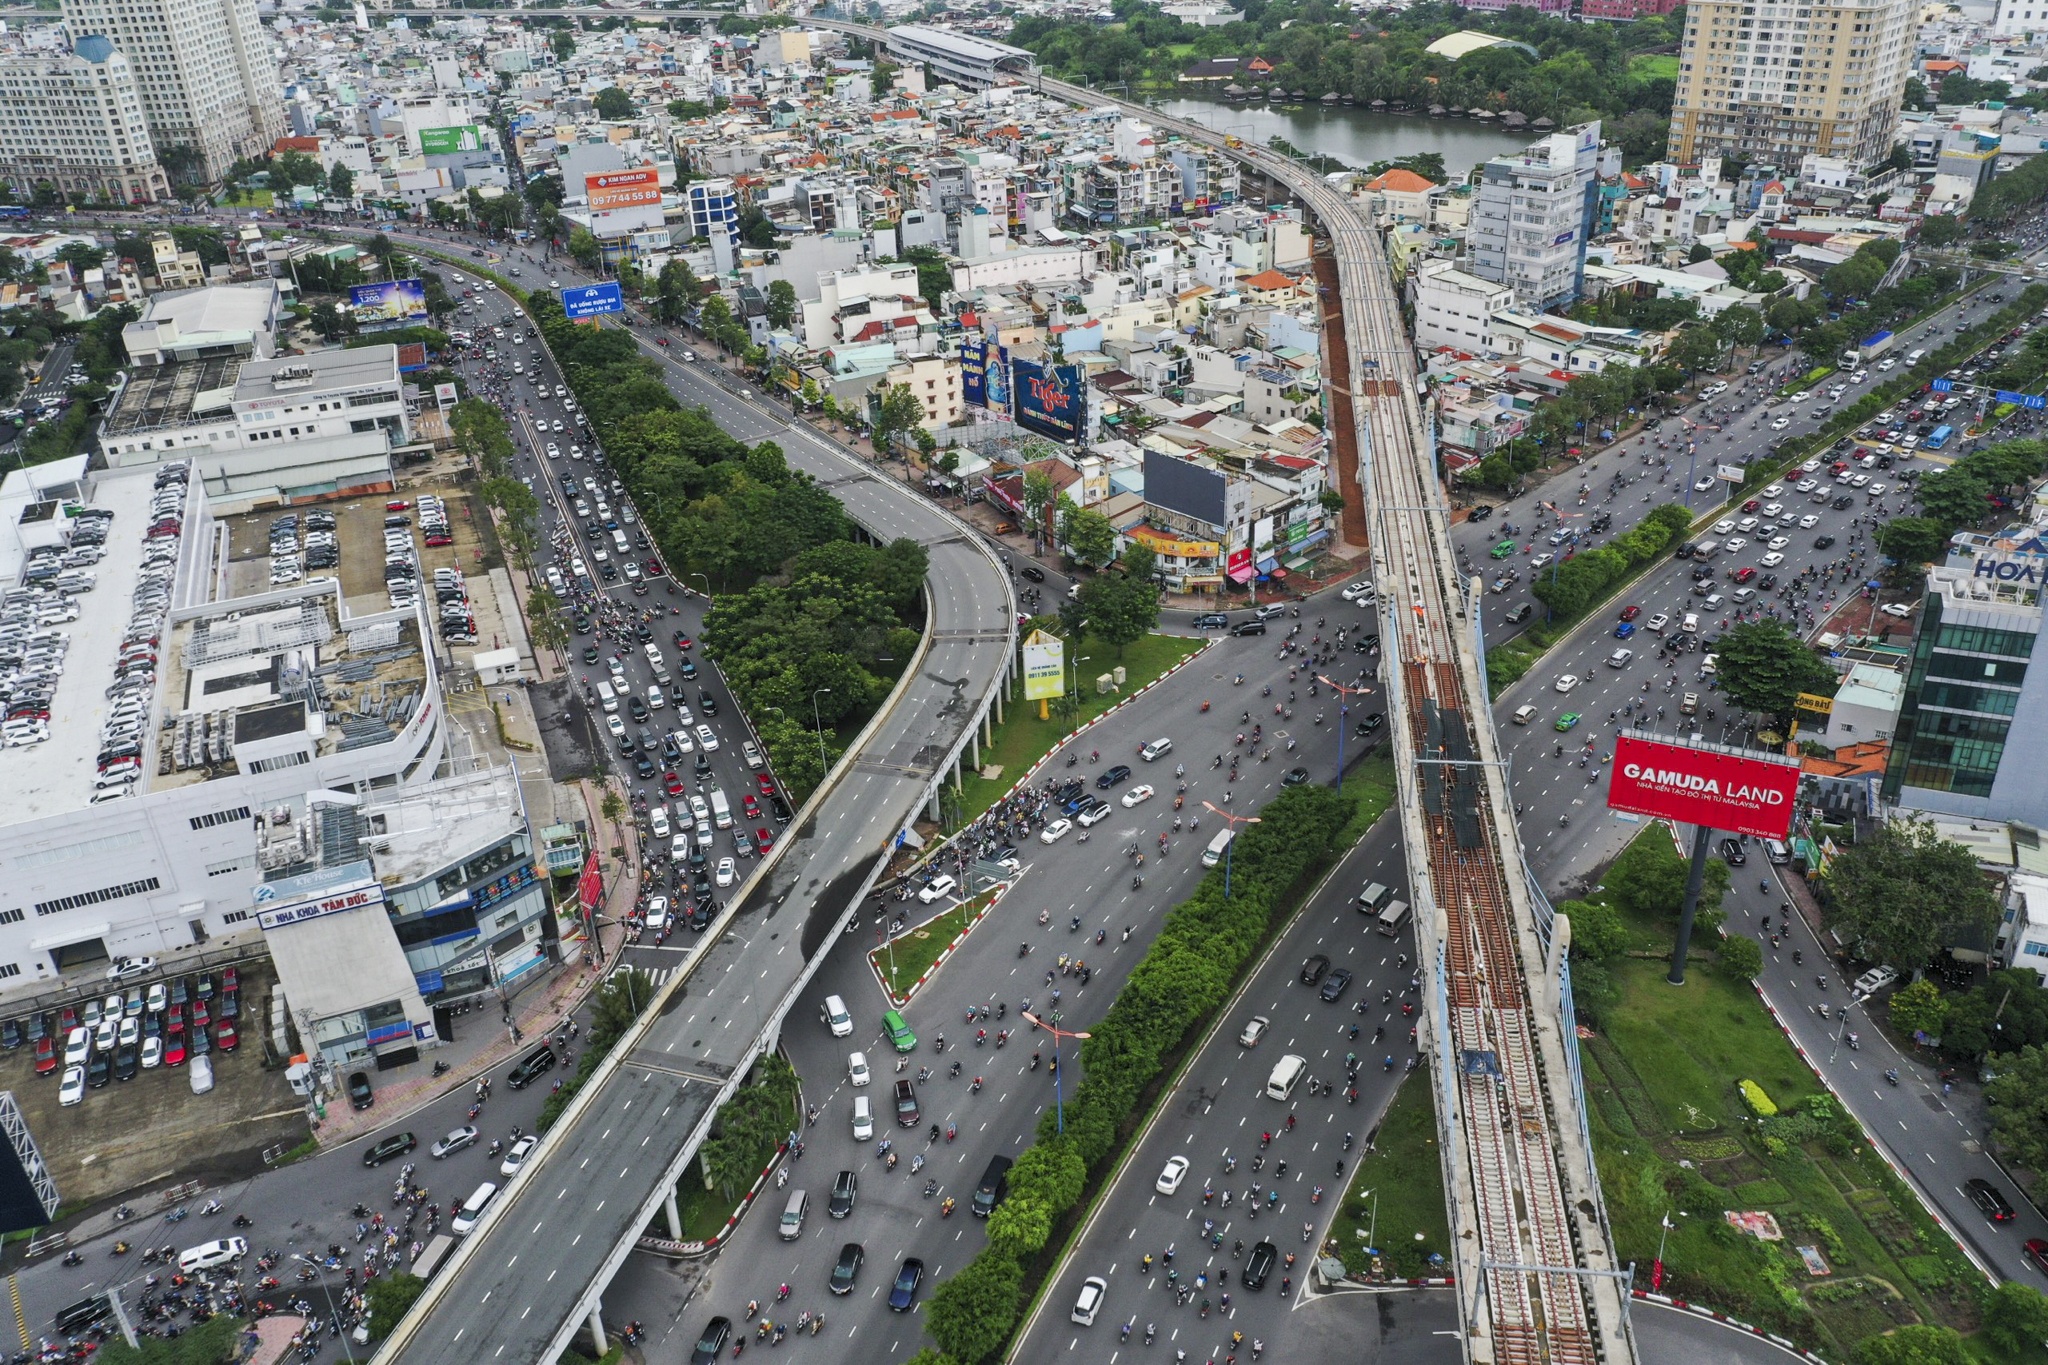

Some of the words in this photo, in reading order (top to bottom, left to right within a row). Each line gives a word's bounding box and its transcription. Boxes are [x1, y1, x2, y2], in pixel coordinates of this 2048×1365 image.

[592, 197, 605, 205] 09
[606, 195, 617, 203] 77
[619, 193, 630, 202] 44
[632, 192, 644, 201] 55
[645, 190, 658, 199] 88
[360, 295, 380, 303] 1.200
[1028, 376, 1071, 412] Tiger
[260, 399, 286, 407] TOYOTA
[1623, 763, 1719, 795] GAMUDA
[1726, 781, 1783, 805] LAND
[1636, 781, 1653, 789] NHÀ
[1654, 784, 1670, 793] KIẾN
[1671, 787, 1687, 796] TẠO
[1687, 790, 1700, 798] ĐÔ
[1701, 793, 1711, 802] THỊ
[1722, 797, 1760, 810] MALAYSIA
[1609, 802, 1672, 818] gamudaland.com.vn
[1737, 826, 1755, 834] 0903
[311, 868, 345, 881] House
[275, 911, 295, 923] NHA
[296, 905, 320, 919] KHOA
[321, 899, 346, 912] TÂM
[347, 892, 368, 907] ĐỨC
